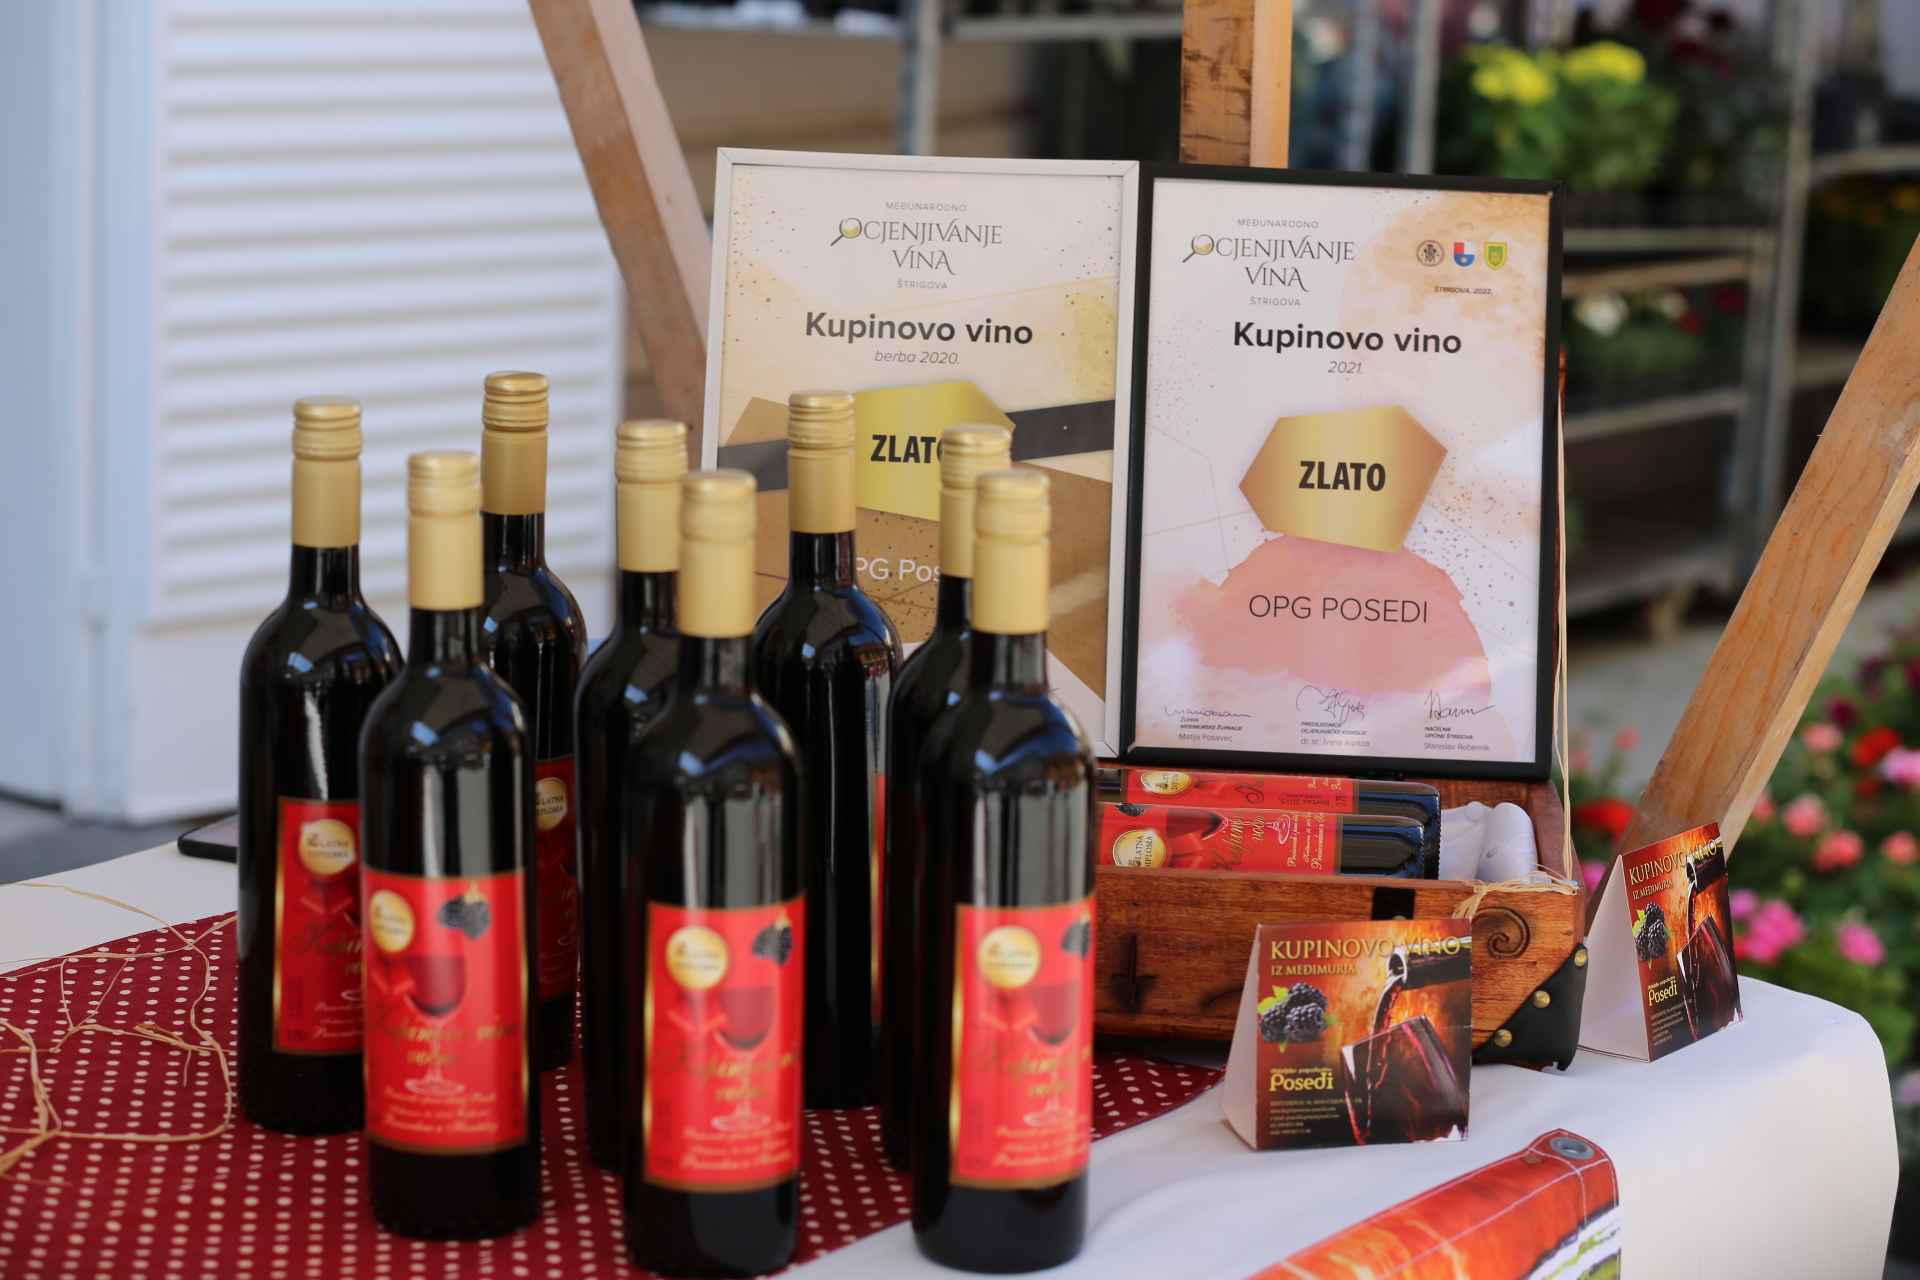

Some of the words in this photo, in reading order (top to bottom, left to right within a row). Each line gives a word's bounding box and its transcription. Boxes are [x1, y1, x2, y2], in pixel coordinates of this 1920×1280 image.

[885, 202, 967, 212] MEĐUNARODNO
[838, 217, 1003, 248] OCJENJIVANJE
[1238, 219, 1319, 229] MEĐUNARODNO
[892, 245, 957, 275] VINA
[1190, 234, 1355, 264] OCJENJIVANJE
[897, 279, 948, 290] ŠTRIGOVA
[1244, 262, 1310, 292] VINA
[1250, 296, 1301, 307] ŠTRIGOVA
[805, 311, 956, 344] Kupinovo
[965, 317, 1034, 345] vino
[1233, 321, 1384, 354] Kupinovo
[1394, 328, 1462, 354] vino
[874, 350, 916, 363] berba
[919, 351, 960, 364] 2020.
[1327, 361, 1364, 374] 2021.
[870, 434, 942, 464] ZLAT
[1298, 461, 1386, 491] ZLATO
[856, 557, 889, 580] PG
[898, 559, 940, 582] Pos
[1249, 594, 1312, 619] OPG
[1322, 597, 1428, 623] POSEDI
[1179, 733, 1200, 742] Matija
[1202, 734, 1233, 742] Posavec
[1344, 739, 1370, 747] Alpeza
[1423, 742, 1456, 750] Stanislav
[1457, 743, 1490, 752] Rebernik
[1628, 850, 1686, 885] KUPINOVO
[1692, 838, 1718, 861] VINO
[1632, 889, 1641, 901] IZ
[1270, 939, 1394, 960] KUPINOVO
[1401, 936, 1461, 956] VINO
[1271, 964, 1283, 976] IZ
[1648, 979, 1679, 1007] Posedi
[1269, 1072, 1334, 1092] Posedi
